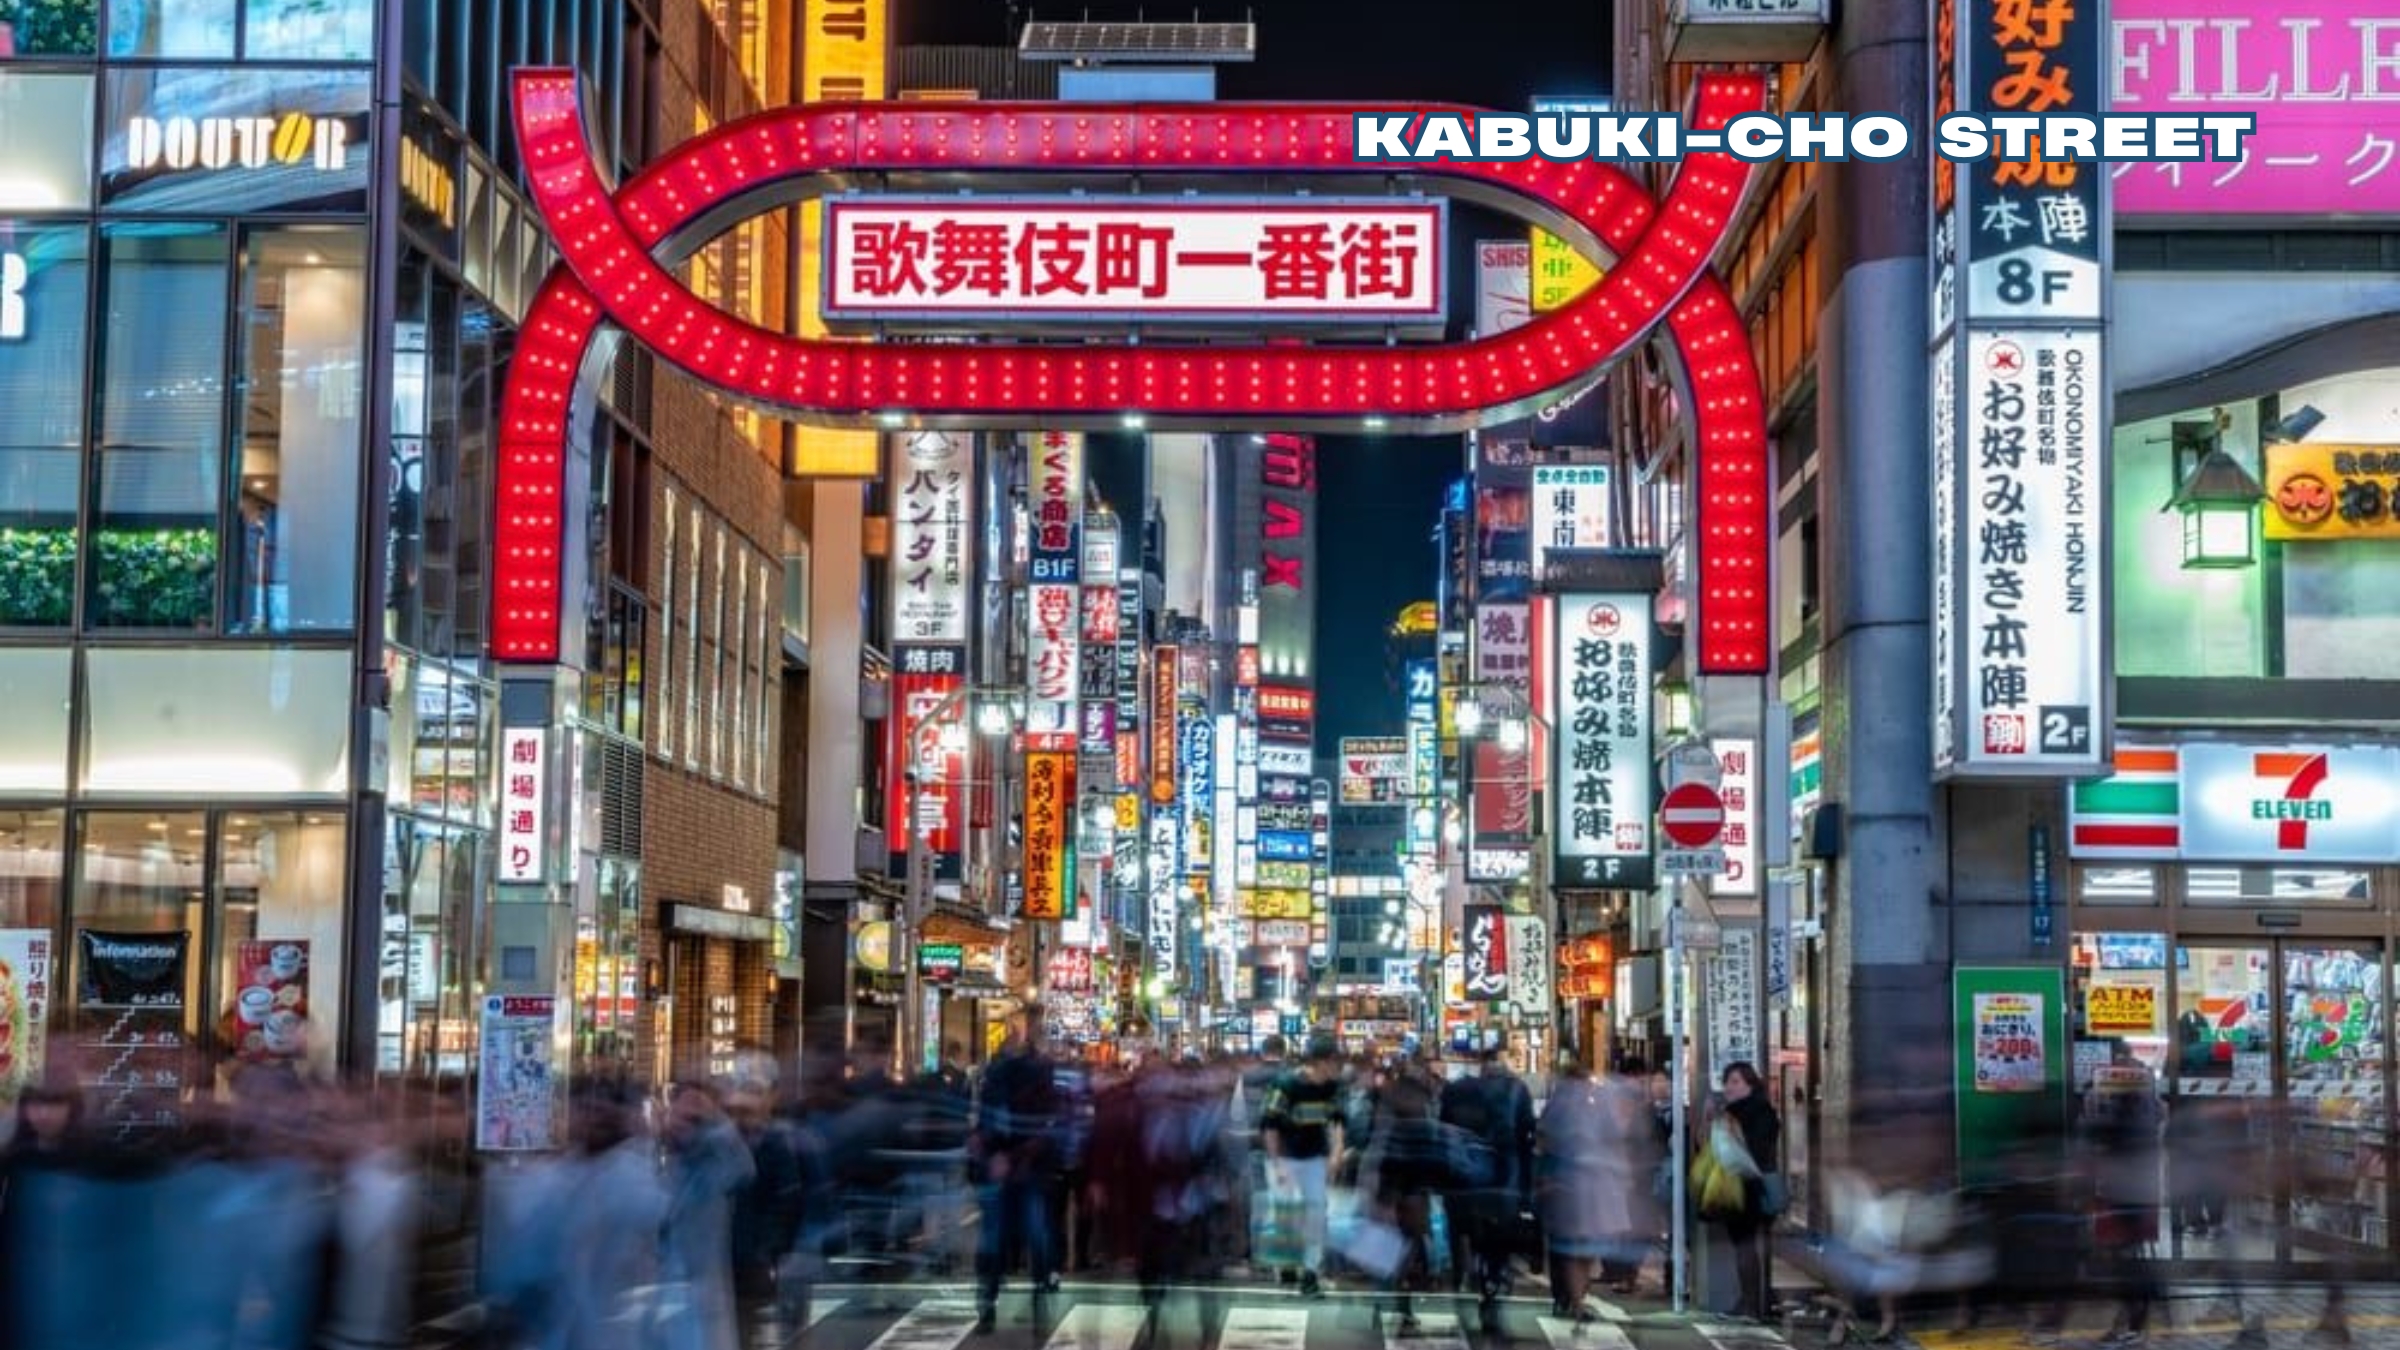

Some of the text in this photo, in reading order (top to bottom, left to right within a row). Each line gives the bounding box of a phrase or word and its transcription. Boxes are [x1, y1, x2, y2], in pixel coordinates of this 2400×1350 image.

[128, 111, 347, 170] DOUTOR
[1980, 193, 2090, 244] 本陣
[851, 219, 1419, 300] 歌舞伎町一番街
[1996, 258, 2073, 306] 8F
[2064, 348, 2085, 614] OKONOMIYAKI HONJIN
[1033, 558, 1077, 577] B1F
[1979, 379, 2029, 710] お好み焼き本陣
[906, 650, 955, 673] 焼肉
[2043, 712, 2088, 747] 2F
[510, 738, 537, 869] 劇場通り
[1582, 860, 1621, 880] 2F
[2090, 987, 2155, 1002] ATM
